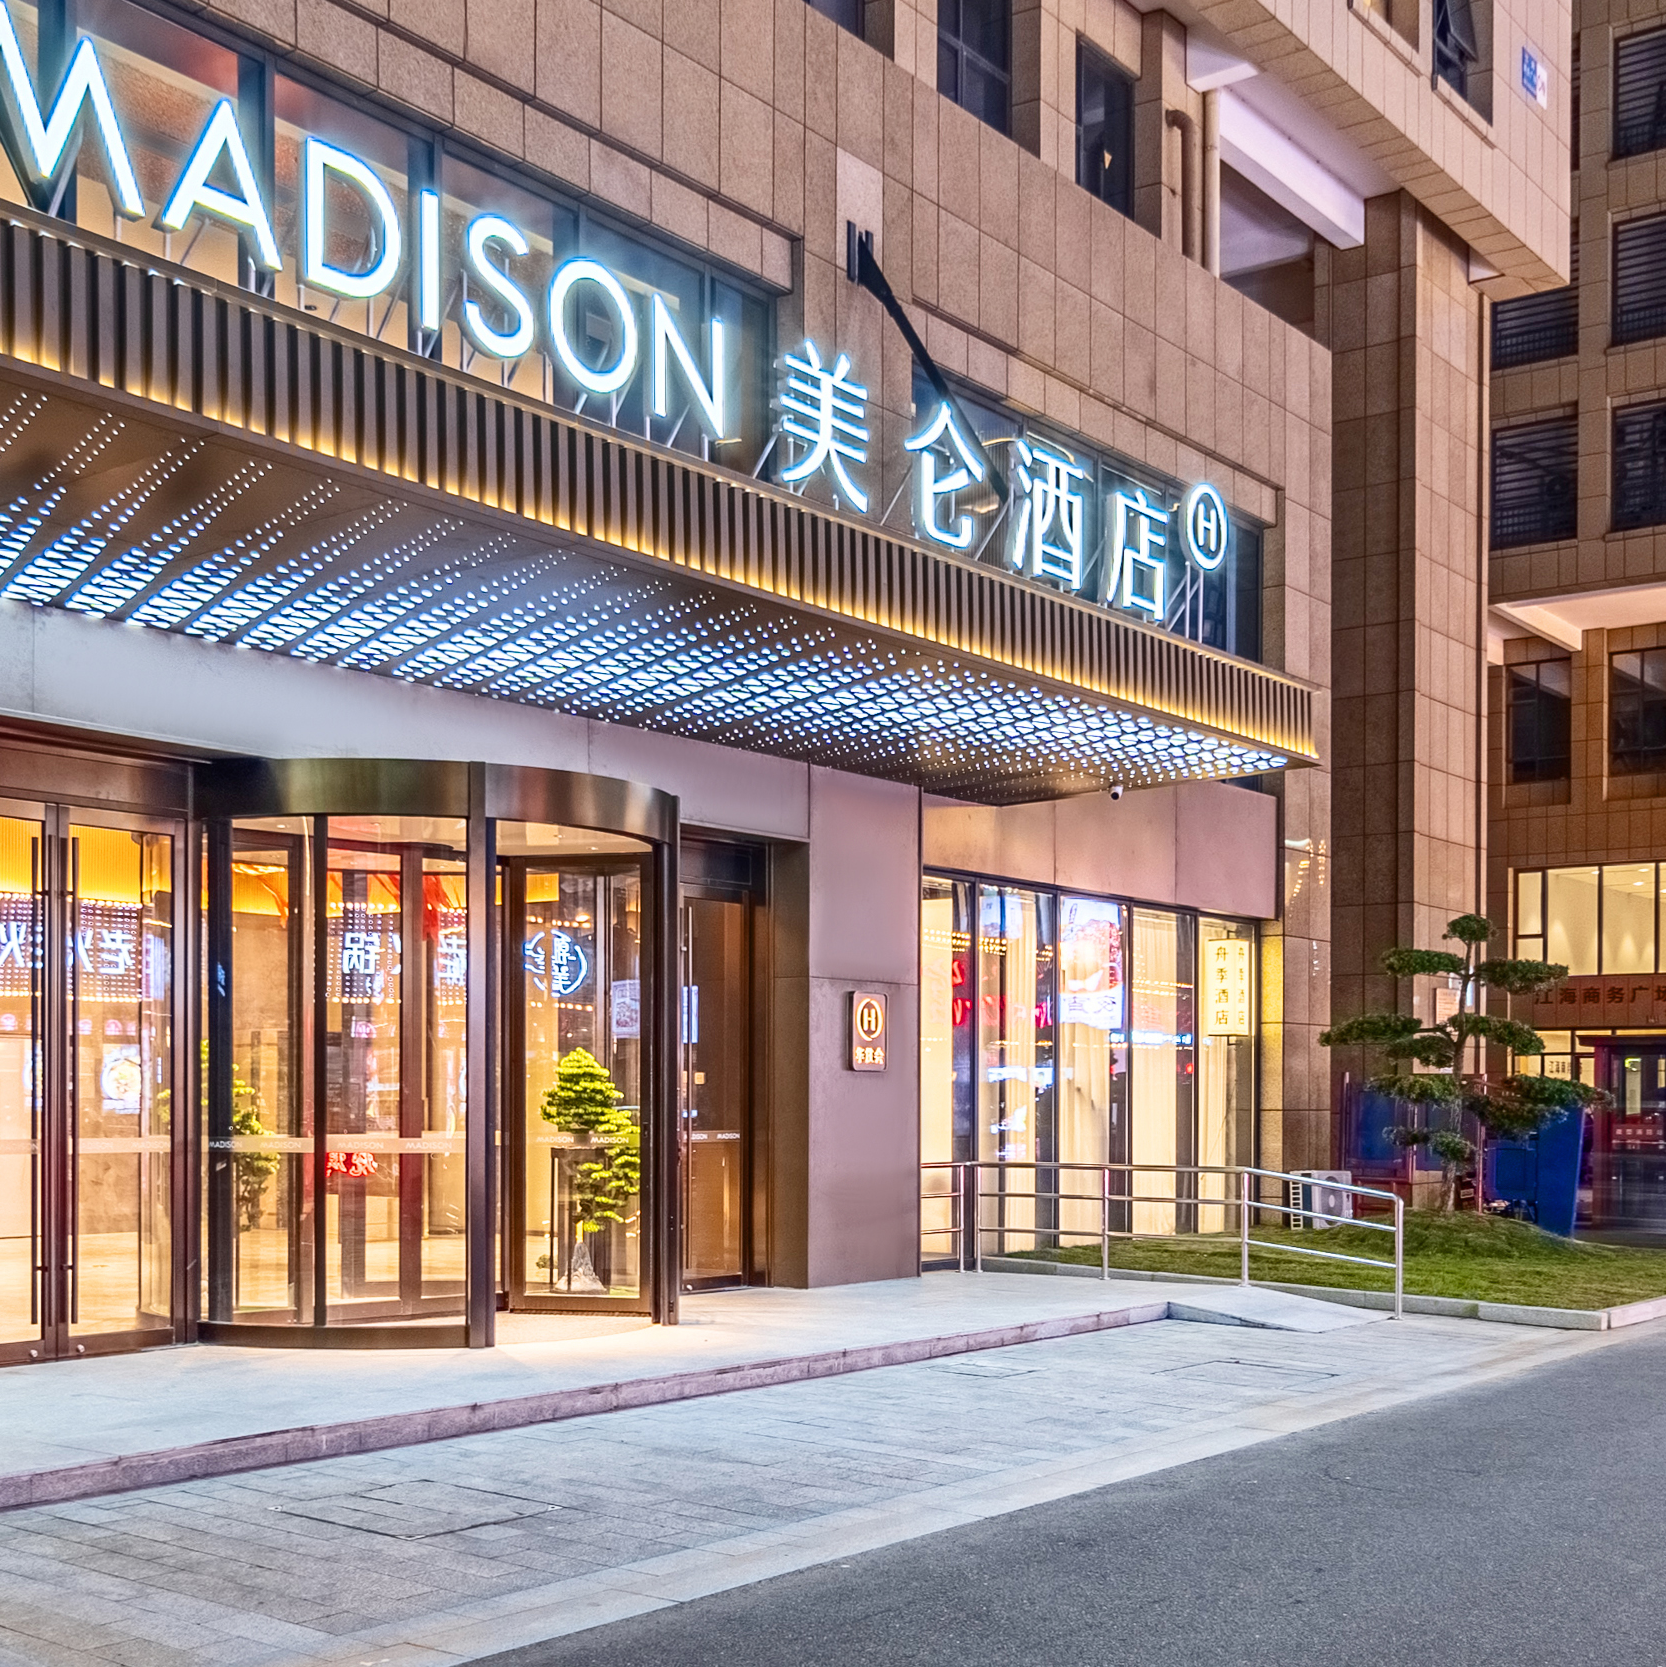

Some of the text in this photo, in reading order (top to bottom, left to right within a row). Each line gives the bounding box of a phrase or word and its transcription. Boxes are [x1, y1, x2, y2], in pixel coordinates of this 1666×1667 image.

[779, 337, 1170, 623] 美仑酒店
[590, 1136, 629, 1144] MADISON
[406, 1142, 452, 1151] MADISON
